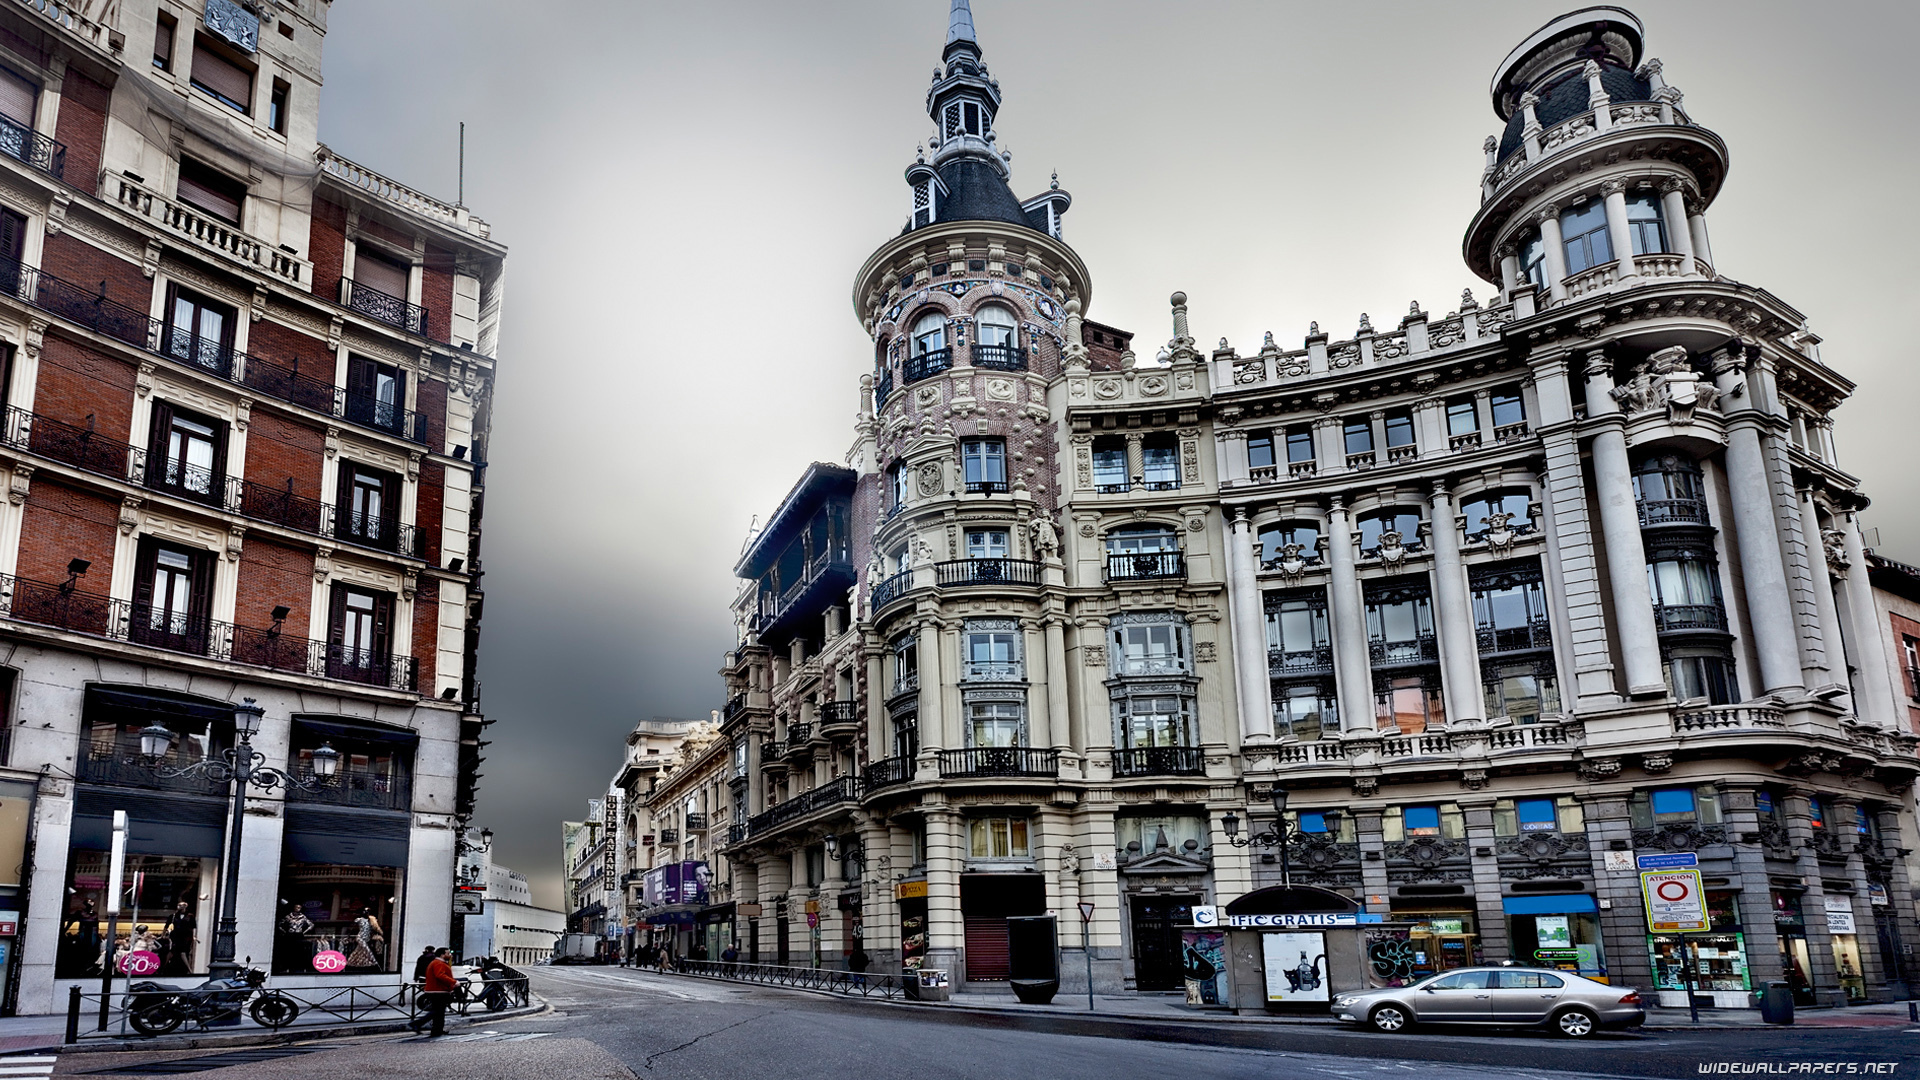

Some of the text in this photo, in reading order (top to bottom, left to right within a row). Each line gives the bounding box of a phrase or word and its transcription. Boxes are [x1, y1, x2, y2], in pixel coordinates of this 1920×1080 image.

[1523, 823, 1554, 831] COPIAS
[605, 796, 616, 890] HOTEL SANTANDER
[1271, 914, 1336, 925] GRATIS
[121, 958, 159, 972] 50%
[315, 957, 347, 970] 50%
